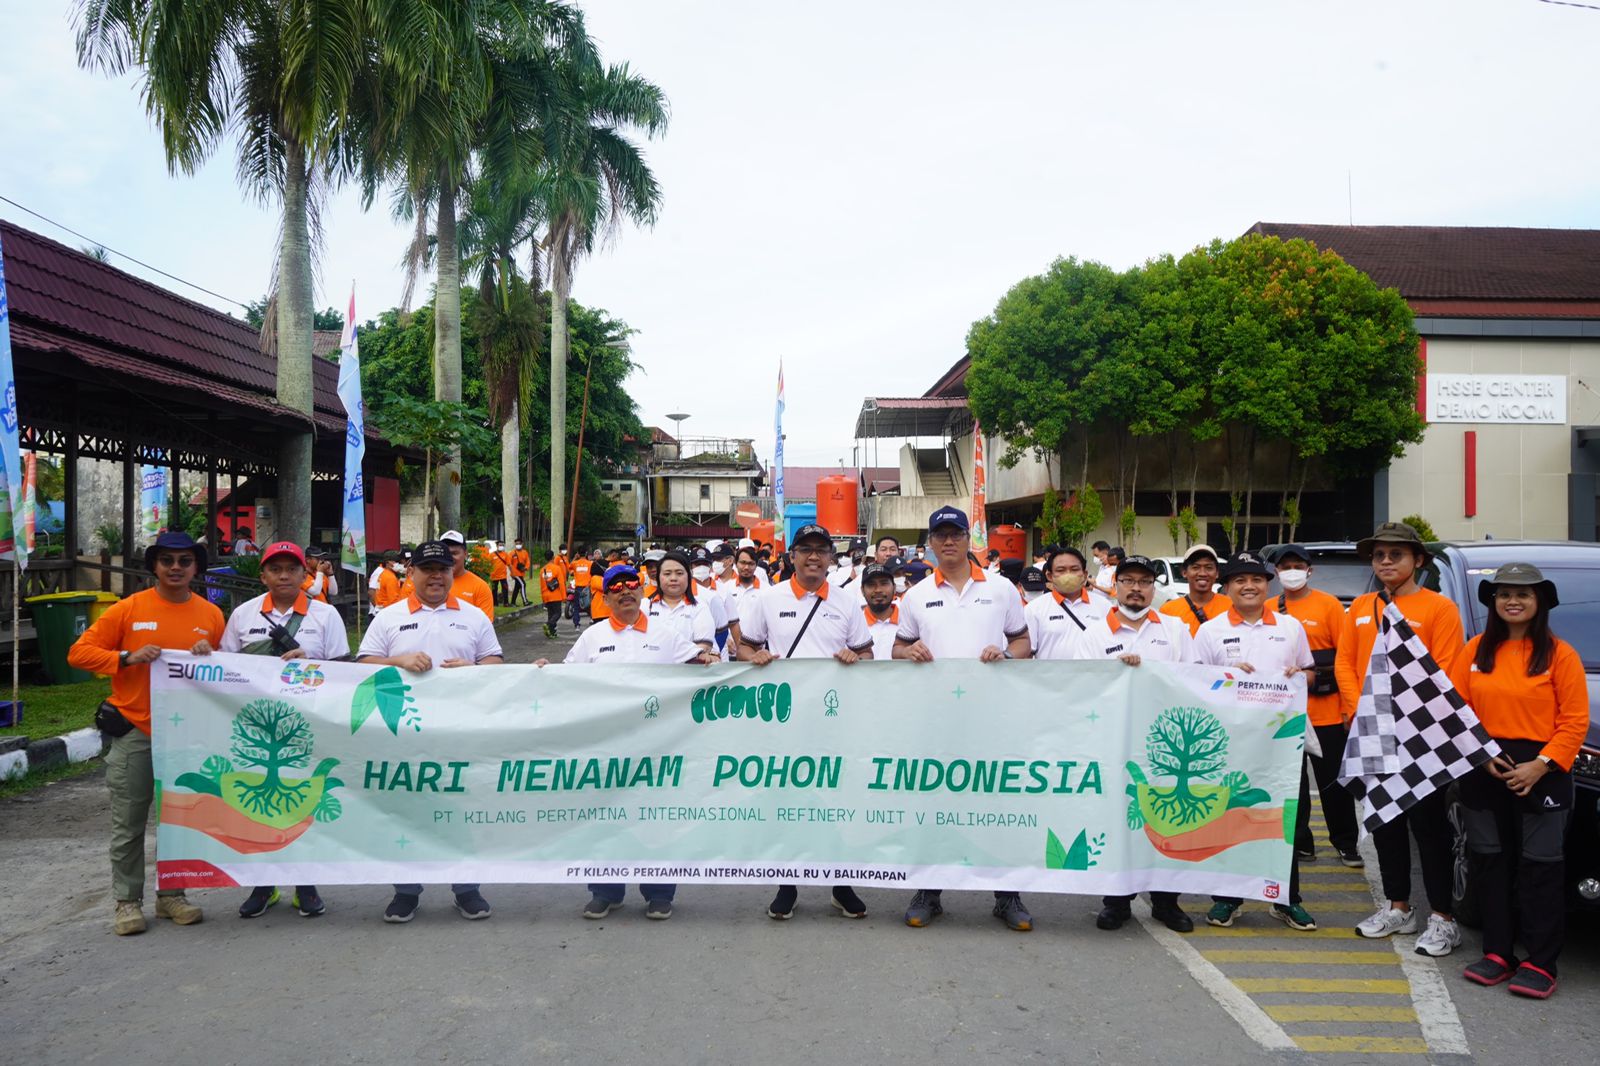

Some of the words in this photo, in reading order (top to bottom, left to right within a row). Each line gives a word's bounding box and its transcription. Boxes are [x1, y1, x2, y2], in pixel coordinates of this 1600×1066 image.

[1437, 379, 1482, 397] HSSE
[1487, 380, 1554, 398] CENTER
[1436, 402, 1491, 419] DEMO
[1497, 403, 1555, 420] ROOM
[1238, 681, 1288, 691] PERTAMINA
[1262, 691, 1293, 699] PERTAMINA
[363, 760, 469, 793] HARI
[497, 755, 683, 793] MENANAM
[712, 755, 842, 789] POHON
[868, 757, 1102, 795] INDONESIA
[434, 811, 453, 824] PT
[465, 810, 526, 824] KILANG
[537, 808, 627, 823] PERTAMINA
[639, 807, 766, 821] INTERNASIONAL
[777, 808, 855, 822] REFINERY
[866, 810, 905, 825] UNIT
[915, 811, 925, 825] V
[936, 811, 1037, 828] BALIKPAPAN
[567, 867, 581, 877] PT
[584, 867, 629, 878] KILANG
[634, 867, 700, 878] PERTAMINA
[704, 867, 799, 878] INTERNASIONAL
[804, 868, 819, 879] RU
[822, 869, 830, 879] V
[834, 869, 906, 881] BALIKPAPAN
